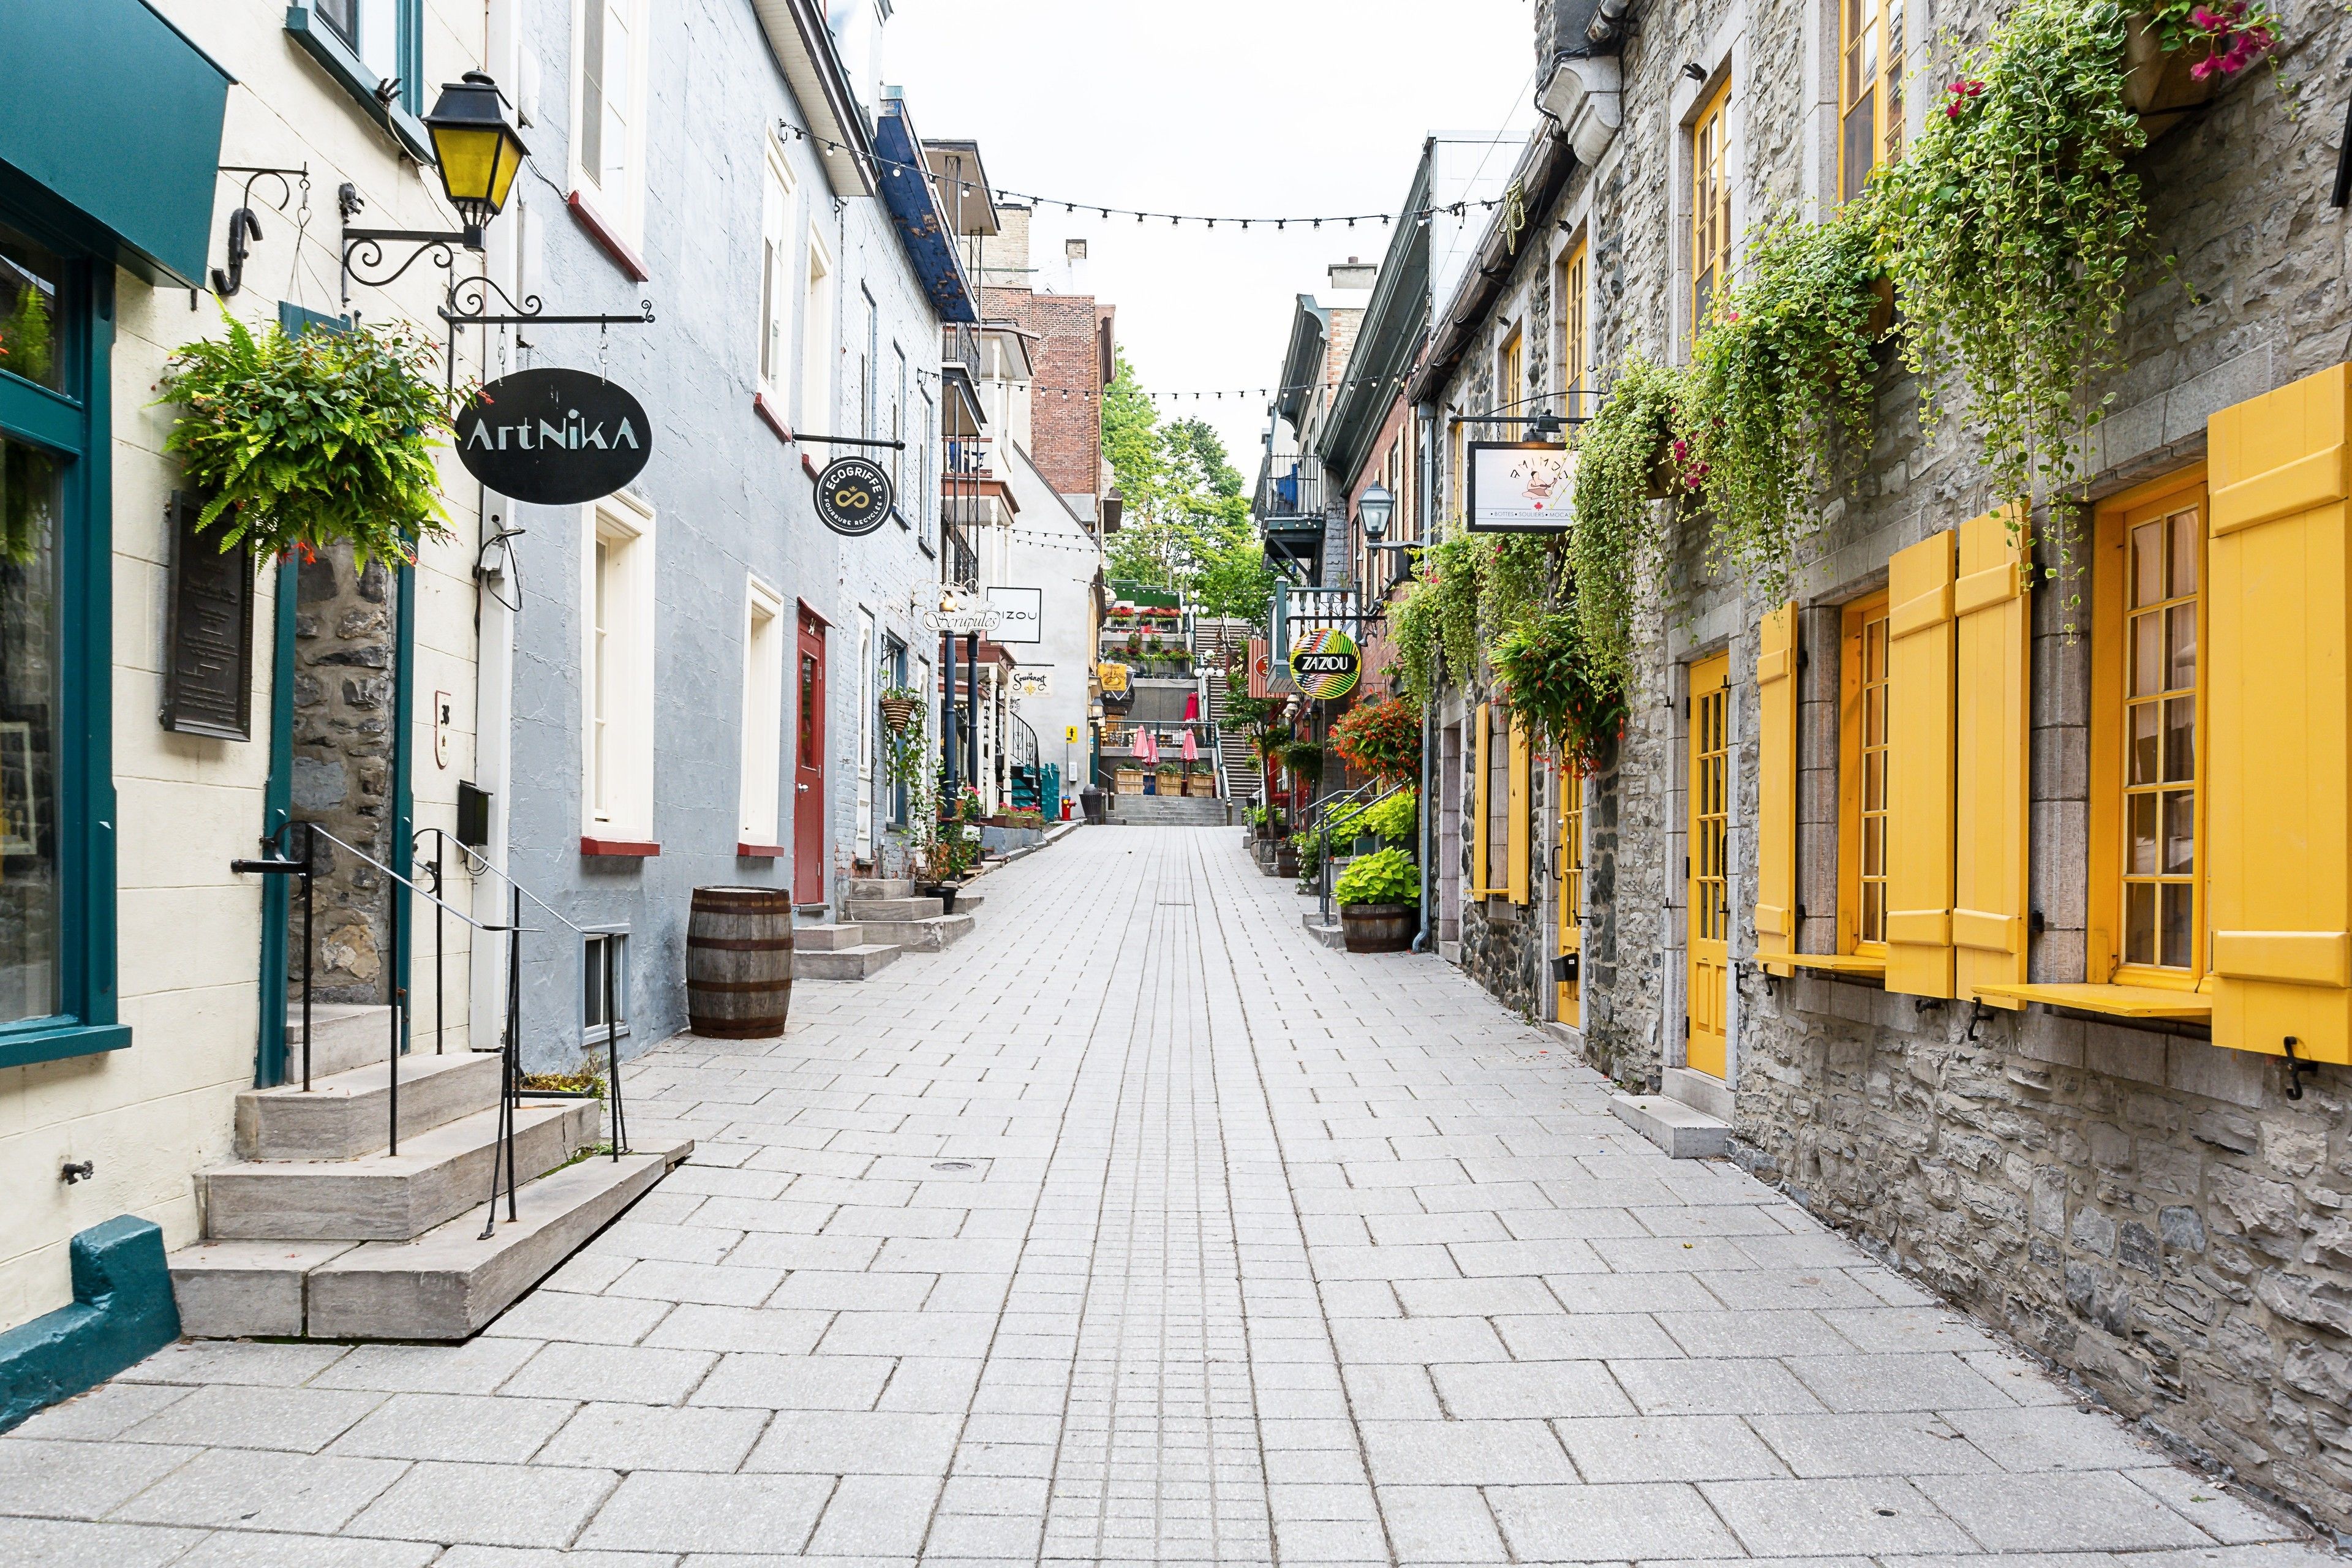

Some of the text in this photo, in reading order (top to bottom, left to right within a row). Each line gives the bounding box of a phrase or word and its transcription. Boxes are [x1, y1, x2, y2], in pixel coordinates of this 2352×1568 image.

[826, 467, 883, 494] ECOGRIFFE
[824, 499, 851, 526] FOURRURE
[925, 613, 997, 632] Scrupules
[997, 611, 1037, 620] IZOU
[1302, 656, 1348, 670] ZAZOU
